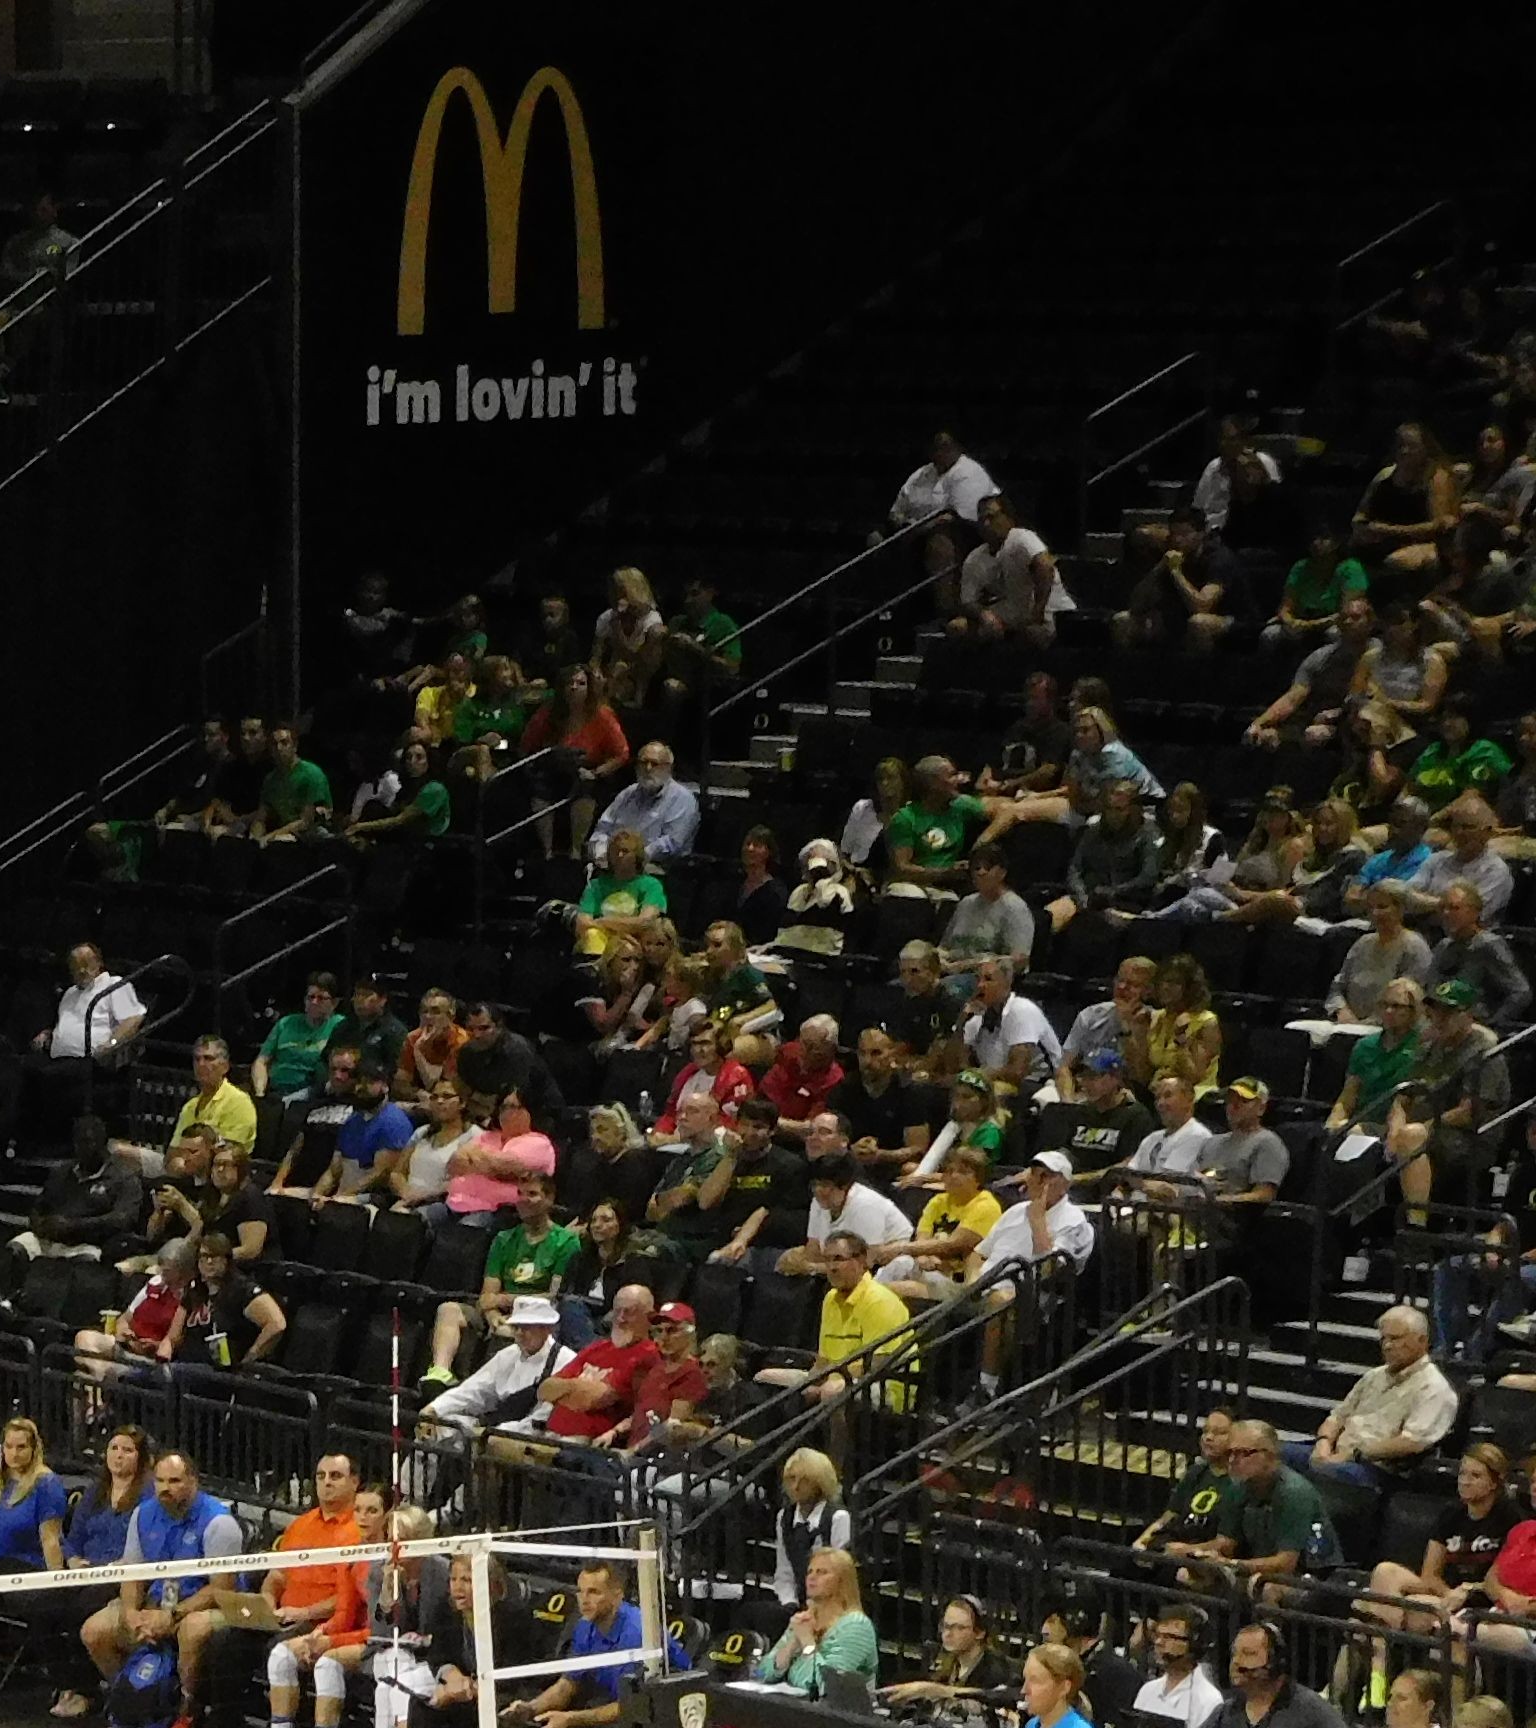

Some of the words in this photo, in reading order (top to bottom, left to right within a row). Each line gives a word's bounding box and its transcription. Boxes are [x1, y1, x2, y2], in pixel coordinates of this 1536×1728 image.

[366, 365, 441, 425] i'm
[455, 358, 593, 422] lovin'
[602, 356, 637, 416] it
[52, 1567, 126, 1582] OREGON
[196, 1555, 270, 1570] OREGON
